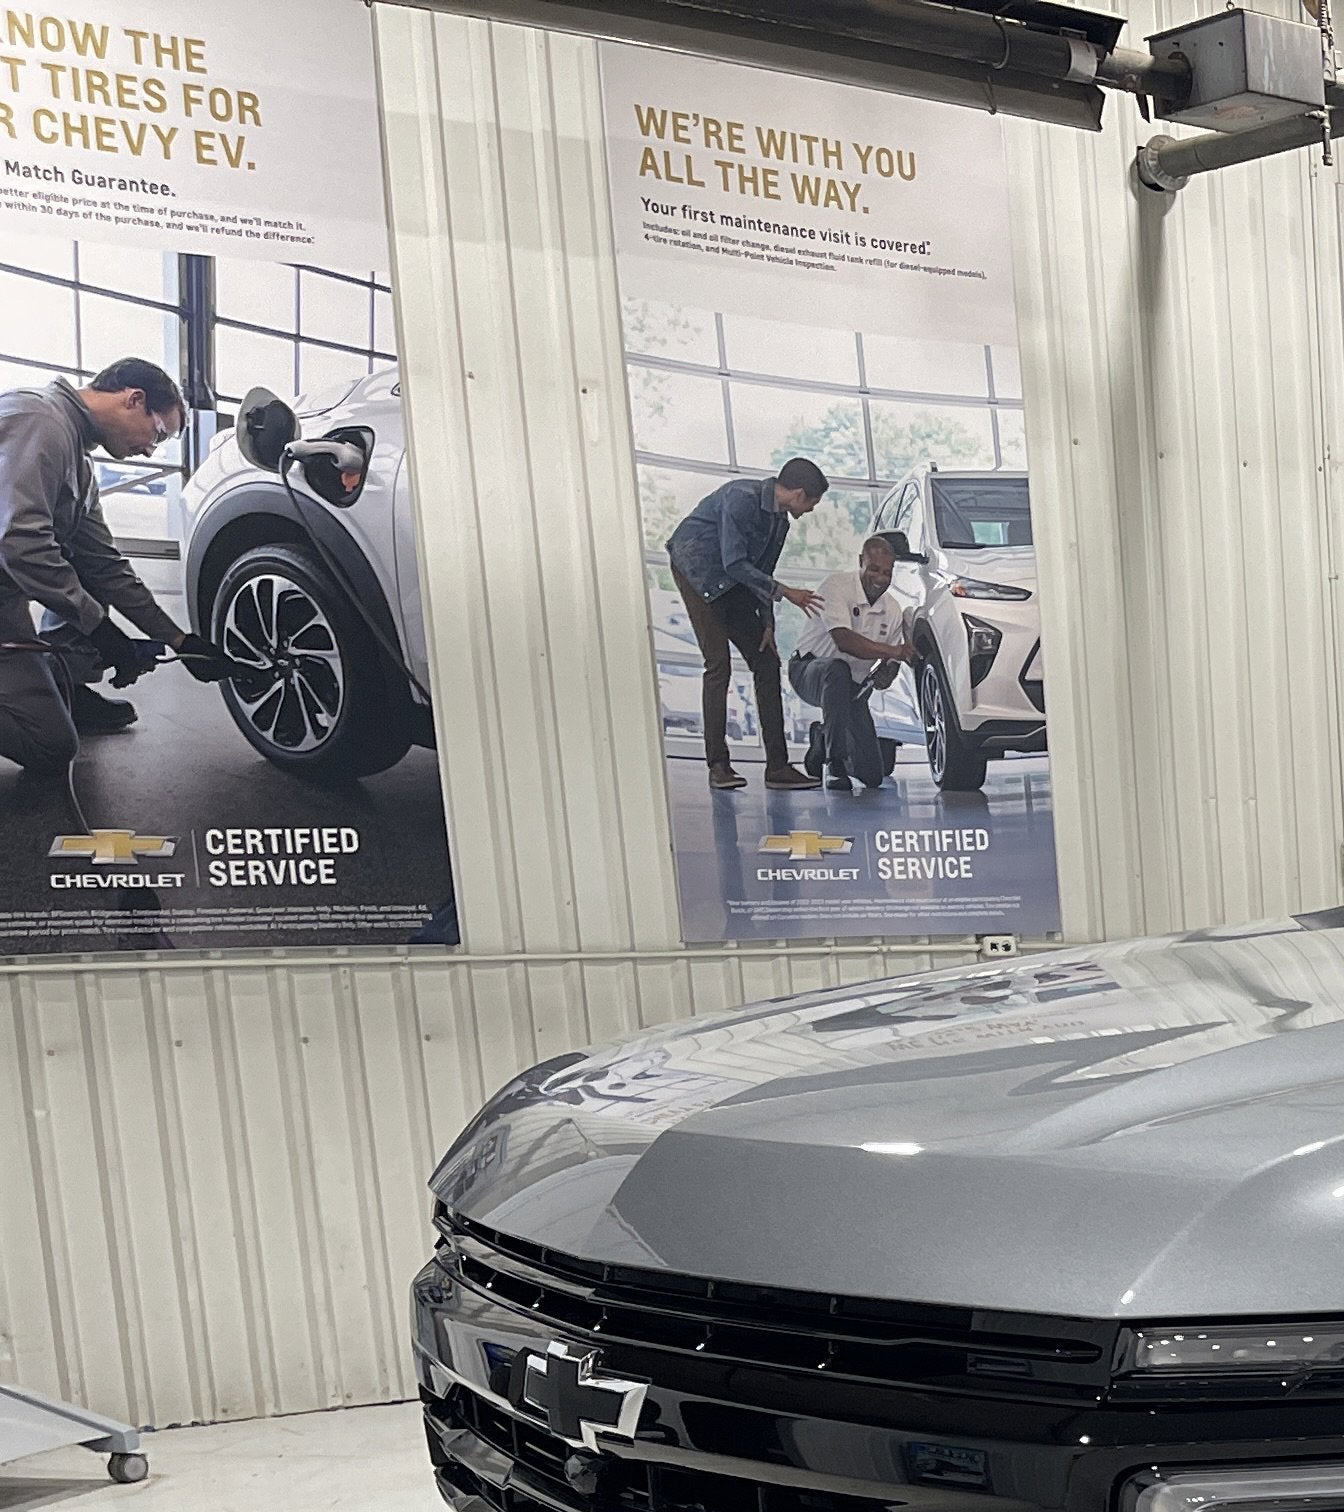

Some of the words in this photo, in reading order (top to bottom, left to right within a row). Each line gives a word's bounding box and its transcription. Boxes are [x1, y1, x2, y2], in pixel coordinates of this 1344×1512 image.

[0, 10, 110, 60] NOW
[124, 29, 207, 74] THE
[41, 62, 166, 113] TIRES
[182, 84, 262, 127] FOR
[32, 108, 178, 160] CHEVY
[194, 130, 256, 170] EV.
[633, 104, 746, 154] WE'RE
[755, 126, 843, 171] WITH
[852, 143, 918, 182] YOU
[5, 160, 65, 183] Match
[71, 169, 176, 197] Guarantee.
[639, 147, 705, 188] ALL
[713, 159, 781, 200] THE
[791, 174, 870, 214] WAY.
[5, 201, 37, 212] within
[40, 205, 53, 214] 30
[56, 208, 80, 219] days
[82, 211, 93, 220] of
[96, 212, 112, 222] the
[114, 214, 164, 229] purchase,
[166, 221, 184, 230] and
[210, 226, 242, 237] refund
[245, 230, 261, 238] the
[32, 191, 69, 204] eligible
[72, 197, 97, 208] price
[101, 201, 111, 209] at
[114, 202, 130, 212] the
[133, 204, 154, 214] time
[158, 207, 168, 216] of
[170, 209, 218, 223] purchase,
[220, 214, 237, 224] and
[264, 220, 294, 230] match
[641, 197, 678, 217] Your
[681, 204, 716, 224] first
[720, 214, 816, 240] maintenance
[819, 228, 851, 246] visit
[854, 232, 867, 248] is
[205, 827, 359, 855] CERTIFIED
[875, 829, 989, 853] CERTIFIED
[50, 873, 185, 889] CHEVROLET
[208, 859, 337, 887] SERVICE
[757, 868, 860, 881] CHEVROLET
[878, 857, 972, 880] SERVICE
